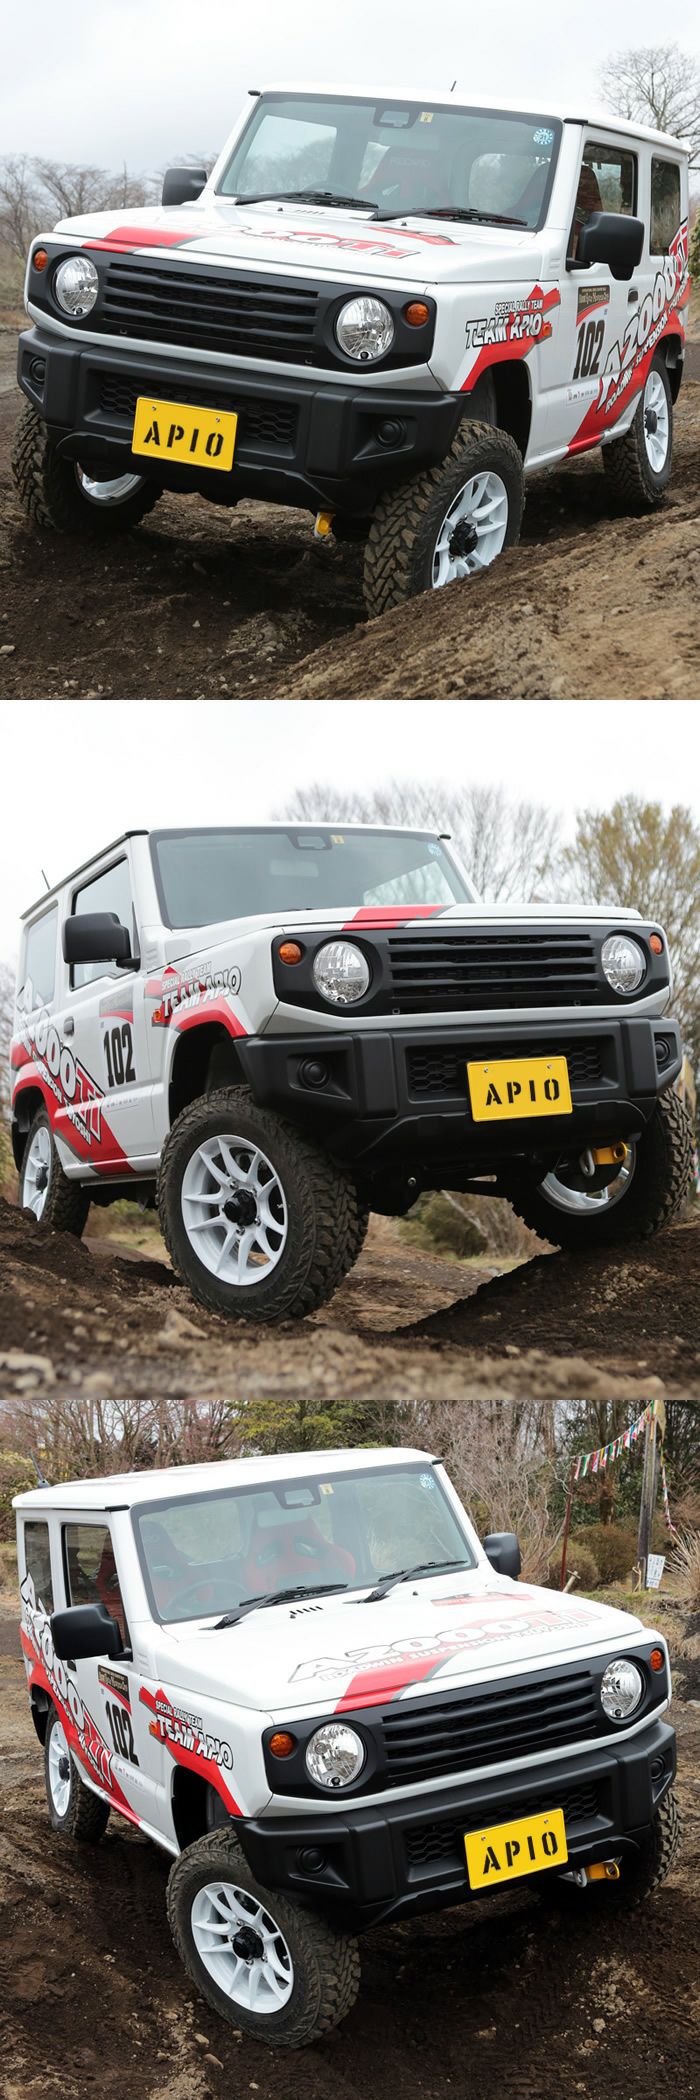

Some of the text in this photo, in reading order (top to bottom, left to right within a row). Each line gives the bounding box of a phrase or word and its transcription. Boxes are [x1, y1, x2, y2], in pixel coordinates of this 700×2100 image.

[531, 298, 544, 311] TEAM
[466, 313, 543, 349] TEAM APIO
[572, 319, 605, 380] 102
[144, 421, 224, 457] APIO
[162, 979, 202, 1019] TEAM
[202, 965, 242, 1004] APIO
[103, 1022, 136, 1089] 102
[485, 1078, 560, 1106] APIO
[105, 1700, 140, 1767] 102
[157, 1712, 234, 1771] TEAM APIO
[482, 1831, 559, 1875] APIO
